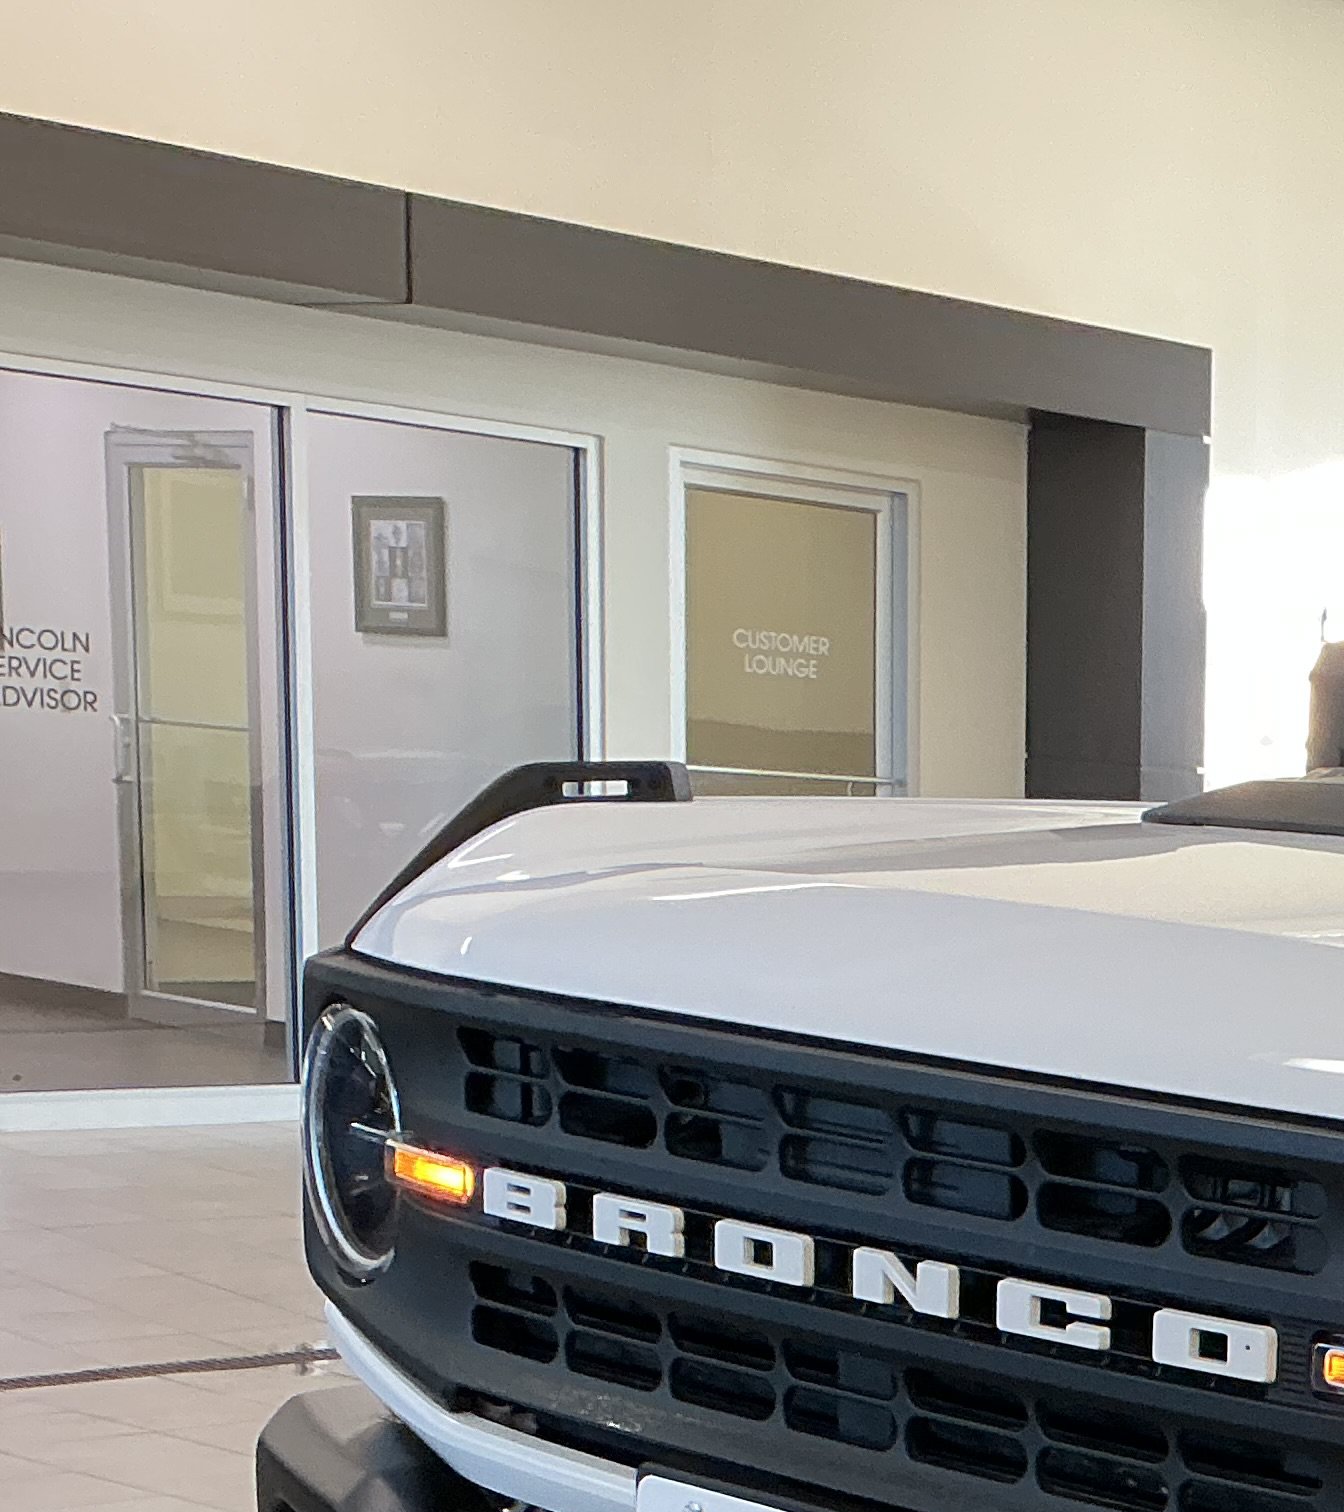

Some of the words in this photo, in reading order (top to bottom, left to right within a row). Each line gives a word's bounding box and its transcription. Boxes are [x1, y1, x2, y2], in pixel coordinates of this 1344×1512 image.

[732, 628, 831, 656] CUSTOMER
[745, 653, 817, 679] LOUNGE
[0, 685, 98, 712] DVISOR
[482, 1166, 1279, 1384] BRONCO
